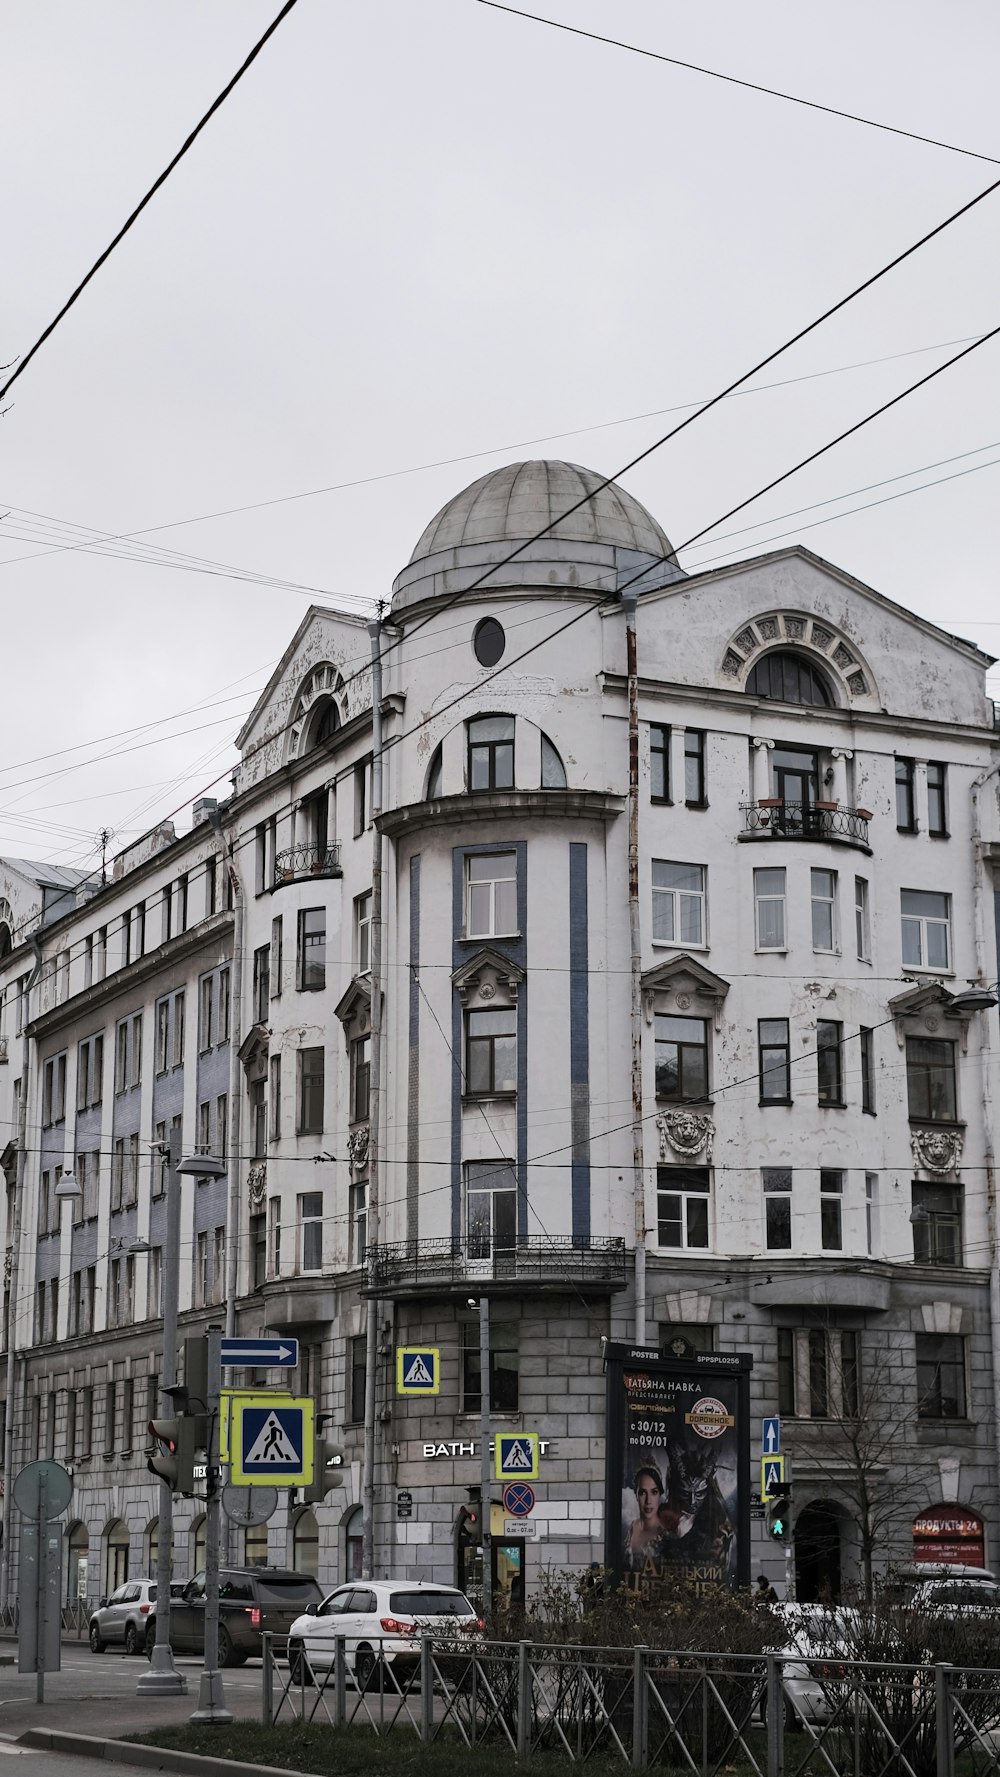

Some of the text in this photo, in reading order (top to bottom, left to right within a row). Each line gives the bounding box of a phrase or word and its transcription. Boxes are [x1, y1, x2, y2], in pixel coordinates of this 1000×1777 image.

[631, 1350, 659, 1360] POSTER
[628, 1378, 702, 1393] ТАТЬЯНА НАВКА
[637, 1420, 666, 1433] 30/12
[639, 1435, 667, 1447] 09/01
[423, 1442, 475, 1458] BATH
[915, 1519, 978, 1533] ПРОДУКТЫ 24
